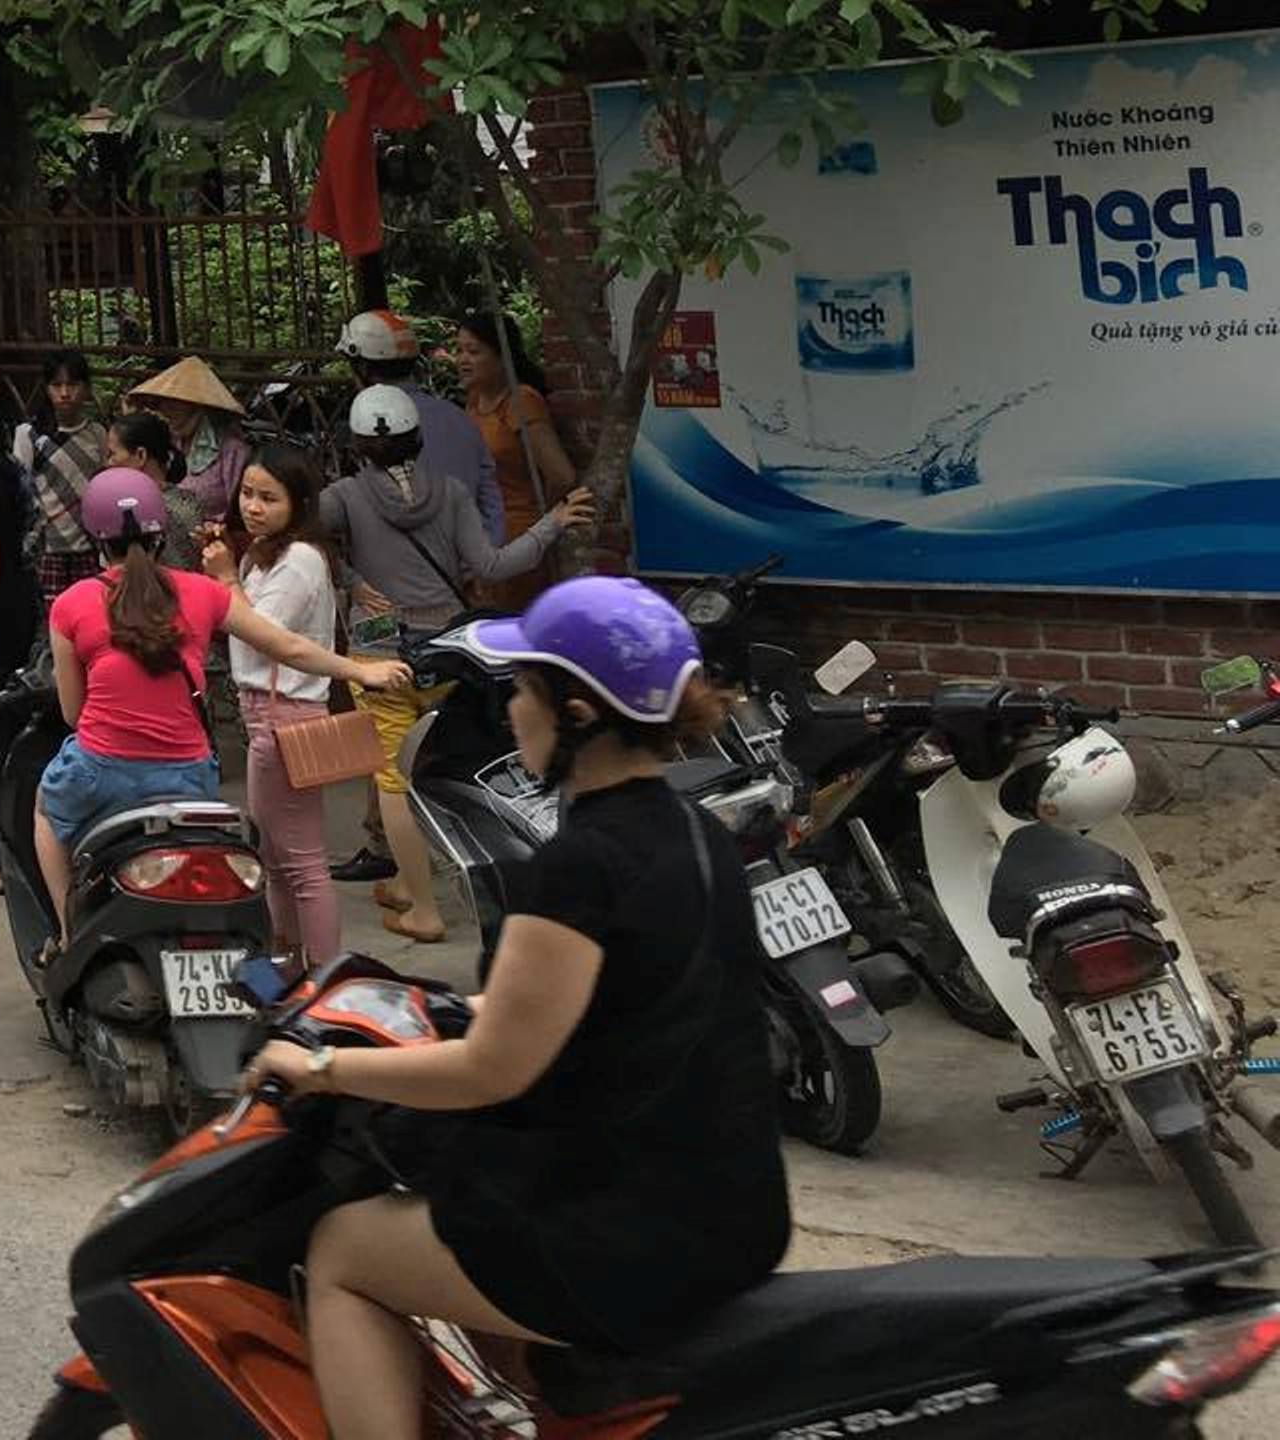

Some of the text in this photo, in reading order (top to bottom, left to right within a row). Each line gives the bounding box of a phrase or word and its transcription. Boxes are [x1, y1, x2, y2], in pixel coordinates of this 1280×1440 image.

[1052, 103, 1214, 128] Nước Khoáng
[1054, 133, 1191, 157] Thiên Nhiên
[1091, 317, 1280, 342] Quà tặng vô giá củ
[752, 877, 818, 919] 74-C1
[1037, 882, 1101, 902] HONDA
[765, 903, 844, 952] 170.72
[1085, 989, 1172, 1038] 74-F2
